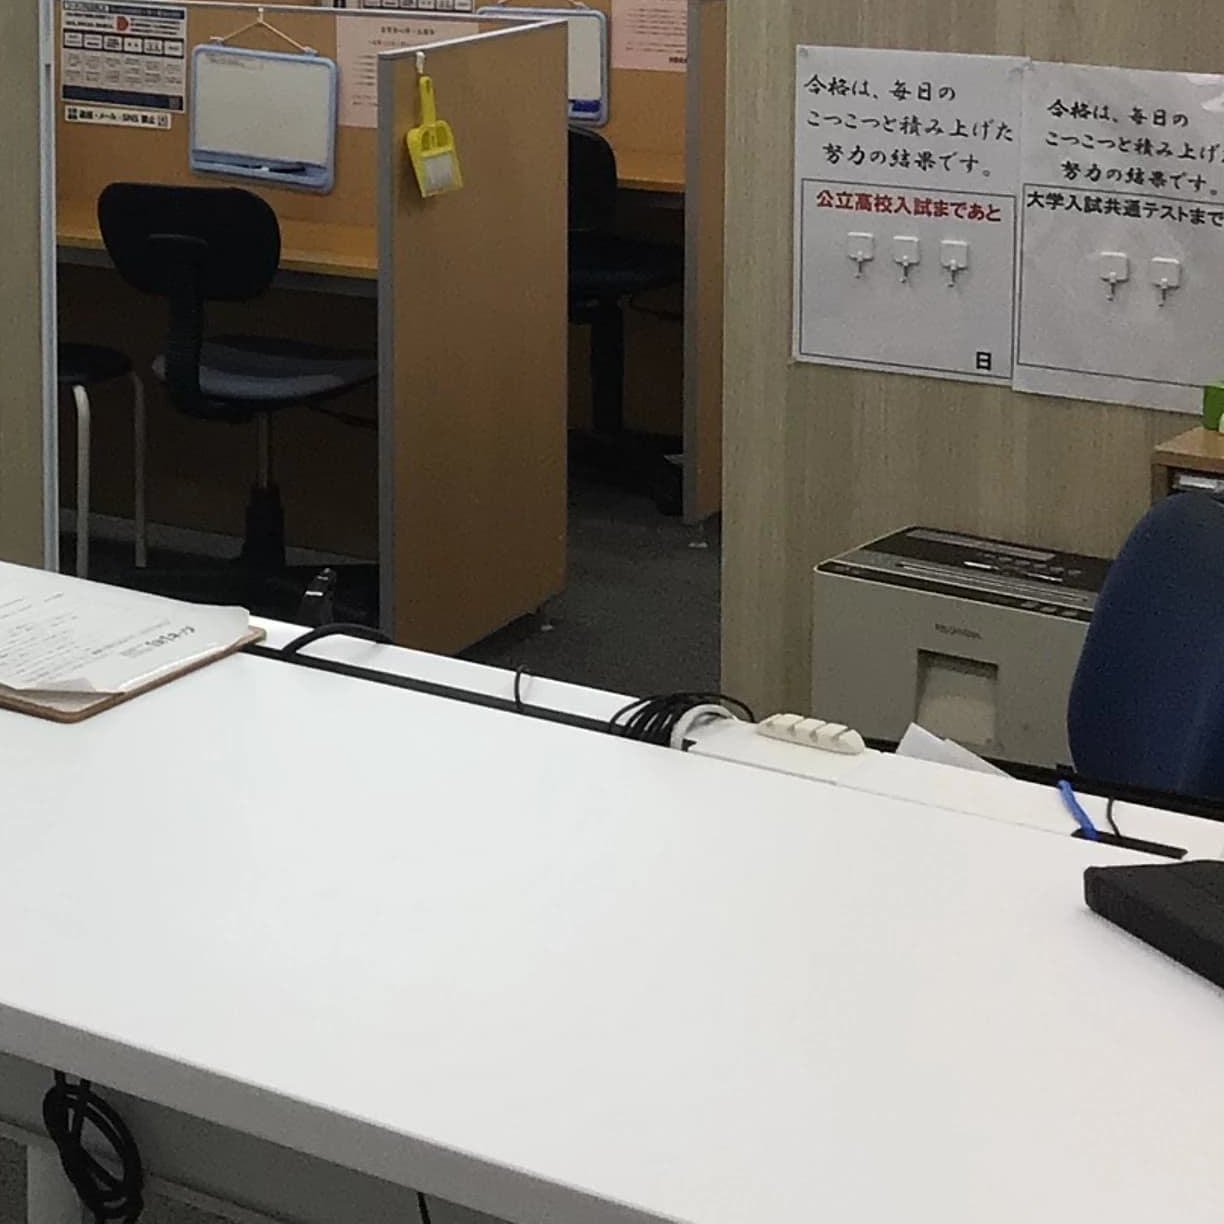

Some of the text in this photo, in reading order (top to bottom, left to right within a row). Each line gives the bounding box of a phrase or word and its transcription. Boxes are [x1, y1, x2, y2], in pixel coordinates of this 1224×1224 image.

[803, 73, 957, 102] 合格は、毎日の
[806, 110, 1015, 143] こつこつと積み上げた
[1046, 97, 1190, 129] 合格は、毎日の
[822, 142, 992, 178] 努力の結果です。
[1045, 129, 1224, 163] こつこつと積み上げ
[816, 189, 1003, 223] 公立高校入試まであと
